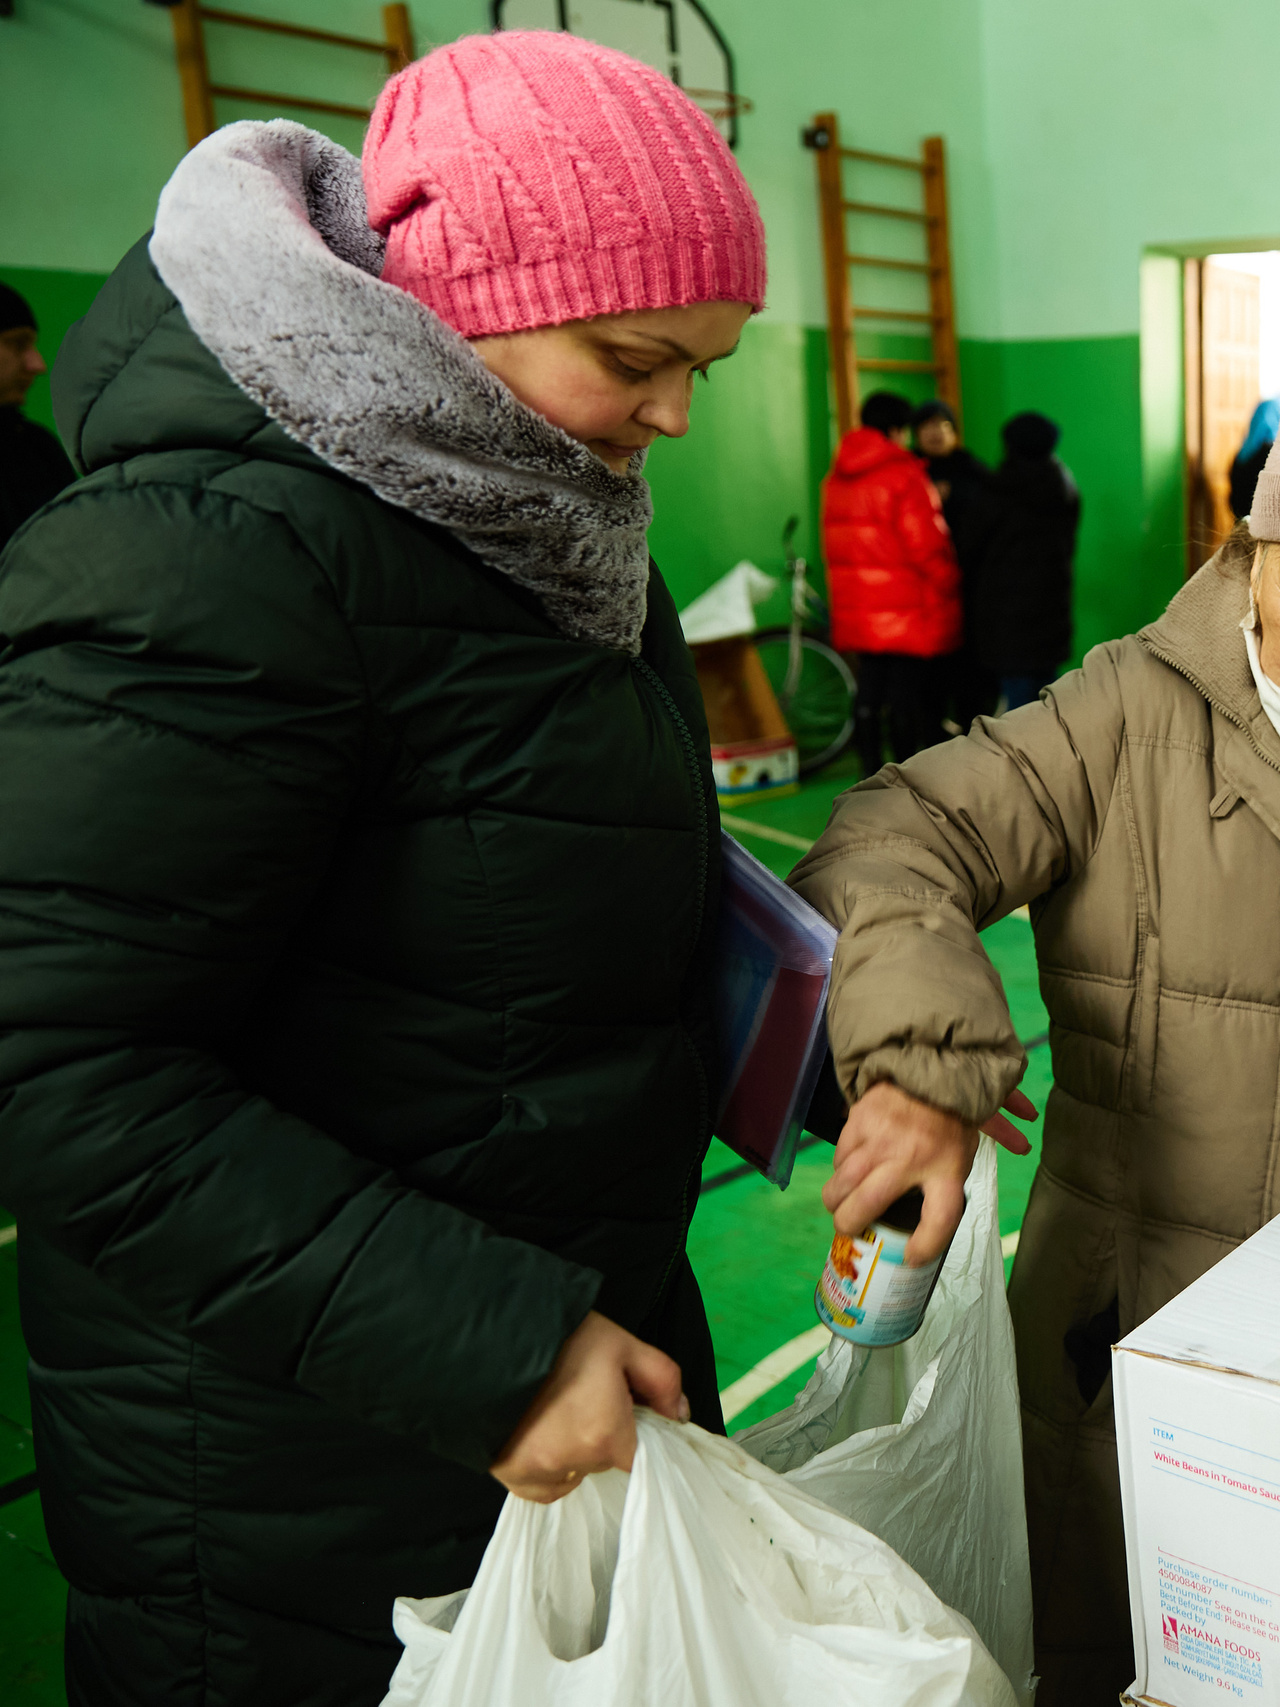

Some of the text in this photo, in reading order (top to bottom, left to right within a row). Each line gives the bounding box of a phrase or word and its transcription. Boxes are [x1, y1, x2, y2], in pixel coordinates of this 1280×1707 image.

[1153, 1428, 1174, 1441] ITEM
[1154, 1450, 1180, 1468] White
[1182, 1461, 1209, 1478] Beans
[1211, 1470, 1220, 1481] in
[1222, 1474, 1257, 1494] Tomato
[1158, 1568, 1212, 1595] 4500084087
[1158, 1556, 1273, 1608] Purchase order number:
[1159, 1578, 1174, 1592] Lot
[1176, 1585, 1212, 1606] number
[1214, 1600, 1232, 1614] See
[1234, 1609, 1248, 1618] on
[1250, 1613, 1266, 1626] the
[1160, 1601, 1206, 1626] Packed by
[1160, 1590, 1176, 1602] Best
[1178, 1596, 1204, 1613] Before
[1206, 1606, 1223, 1621] End:
[1224, 1615, 1250, 1632] Please
[1252, 1626, 1266, 1638] see
[1268, 1632, 1280, 1644] on
[1180, 1623, 1222, 1647] AMANA
[1225, 1640, 1260, 1662] FOODS
[1164, 1656, 1243, 1698] Net Weight 9.6 kg
